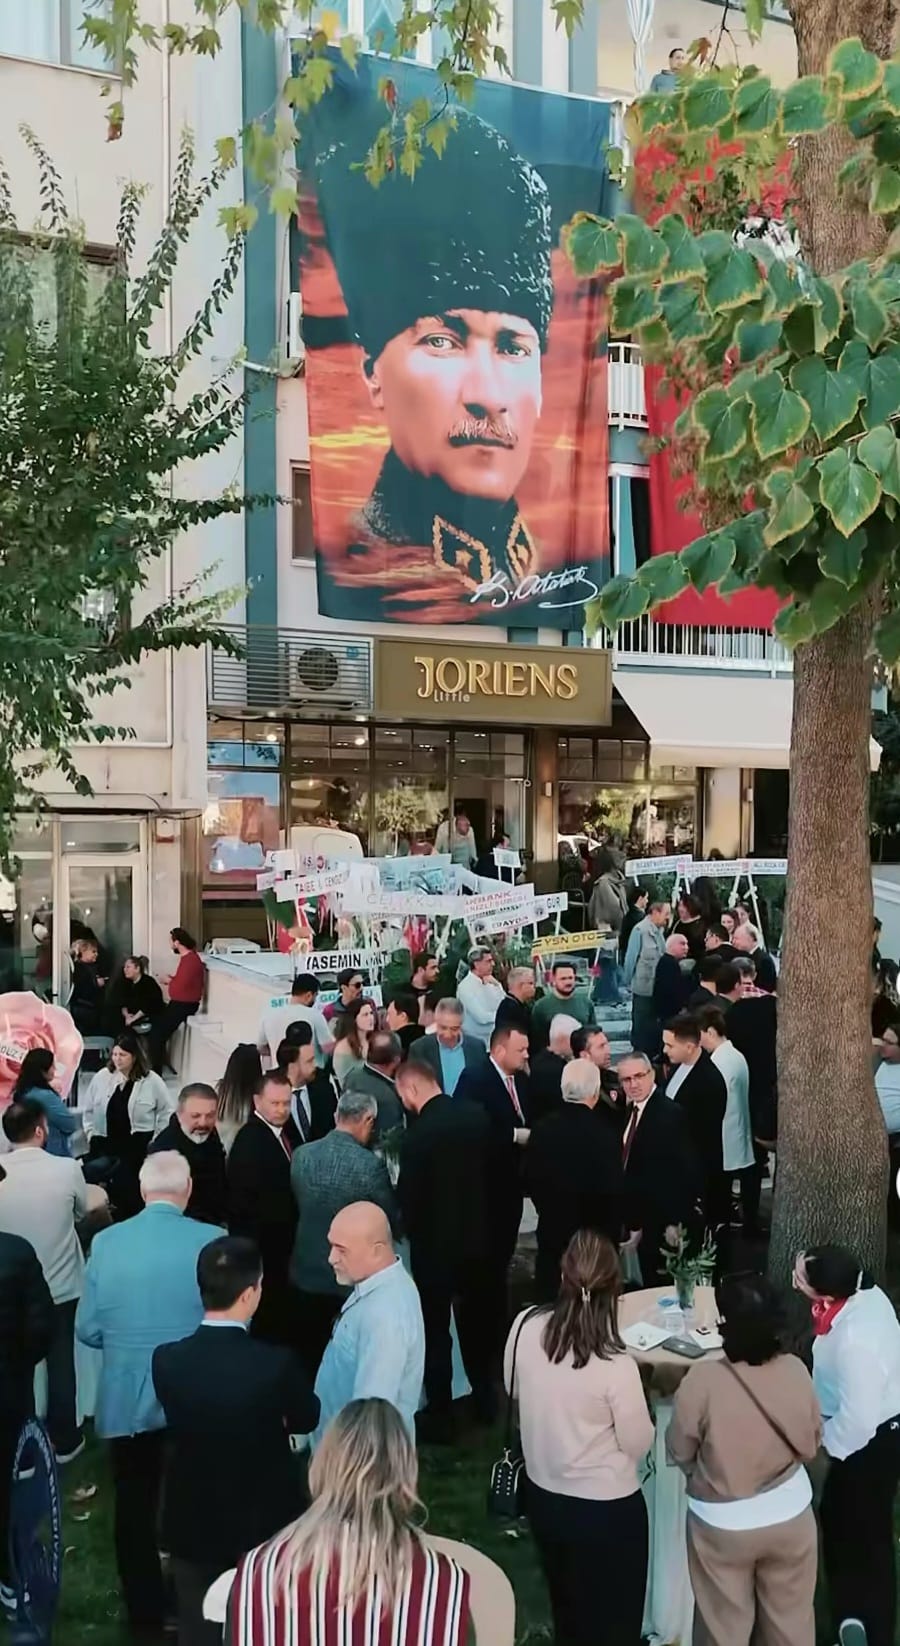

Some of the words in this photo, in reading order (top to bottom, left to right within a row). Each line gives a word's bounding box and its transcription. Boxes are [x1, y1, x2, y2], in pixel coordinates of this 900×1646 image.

[413, 656, 579, 700] JORIENS
[434, 688, 472, 703] Little
[544, 936, 569, 947] YSN
[571, 933, 596, 944] OTO
